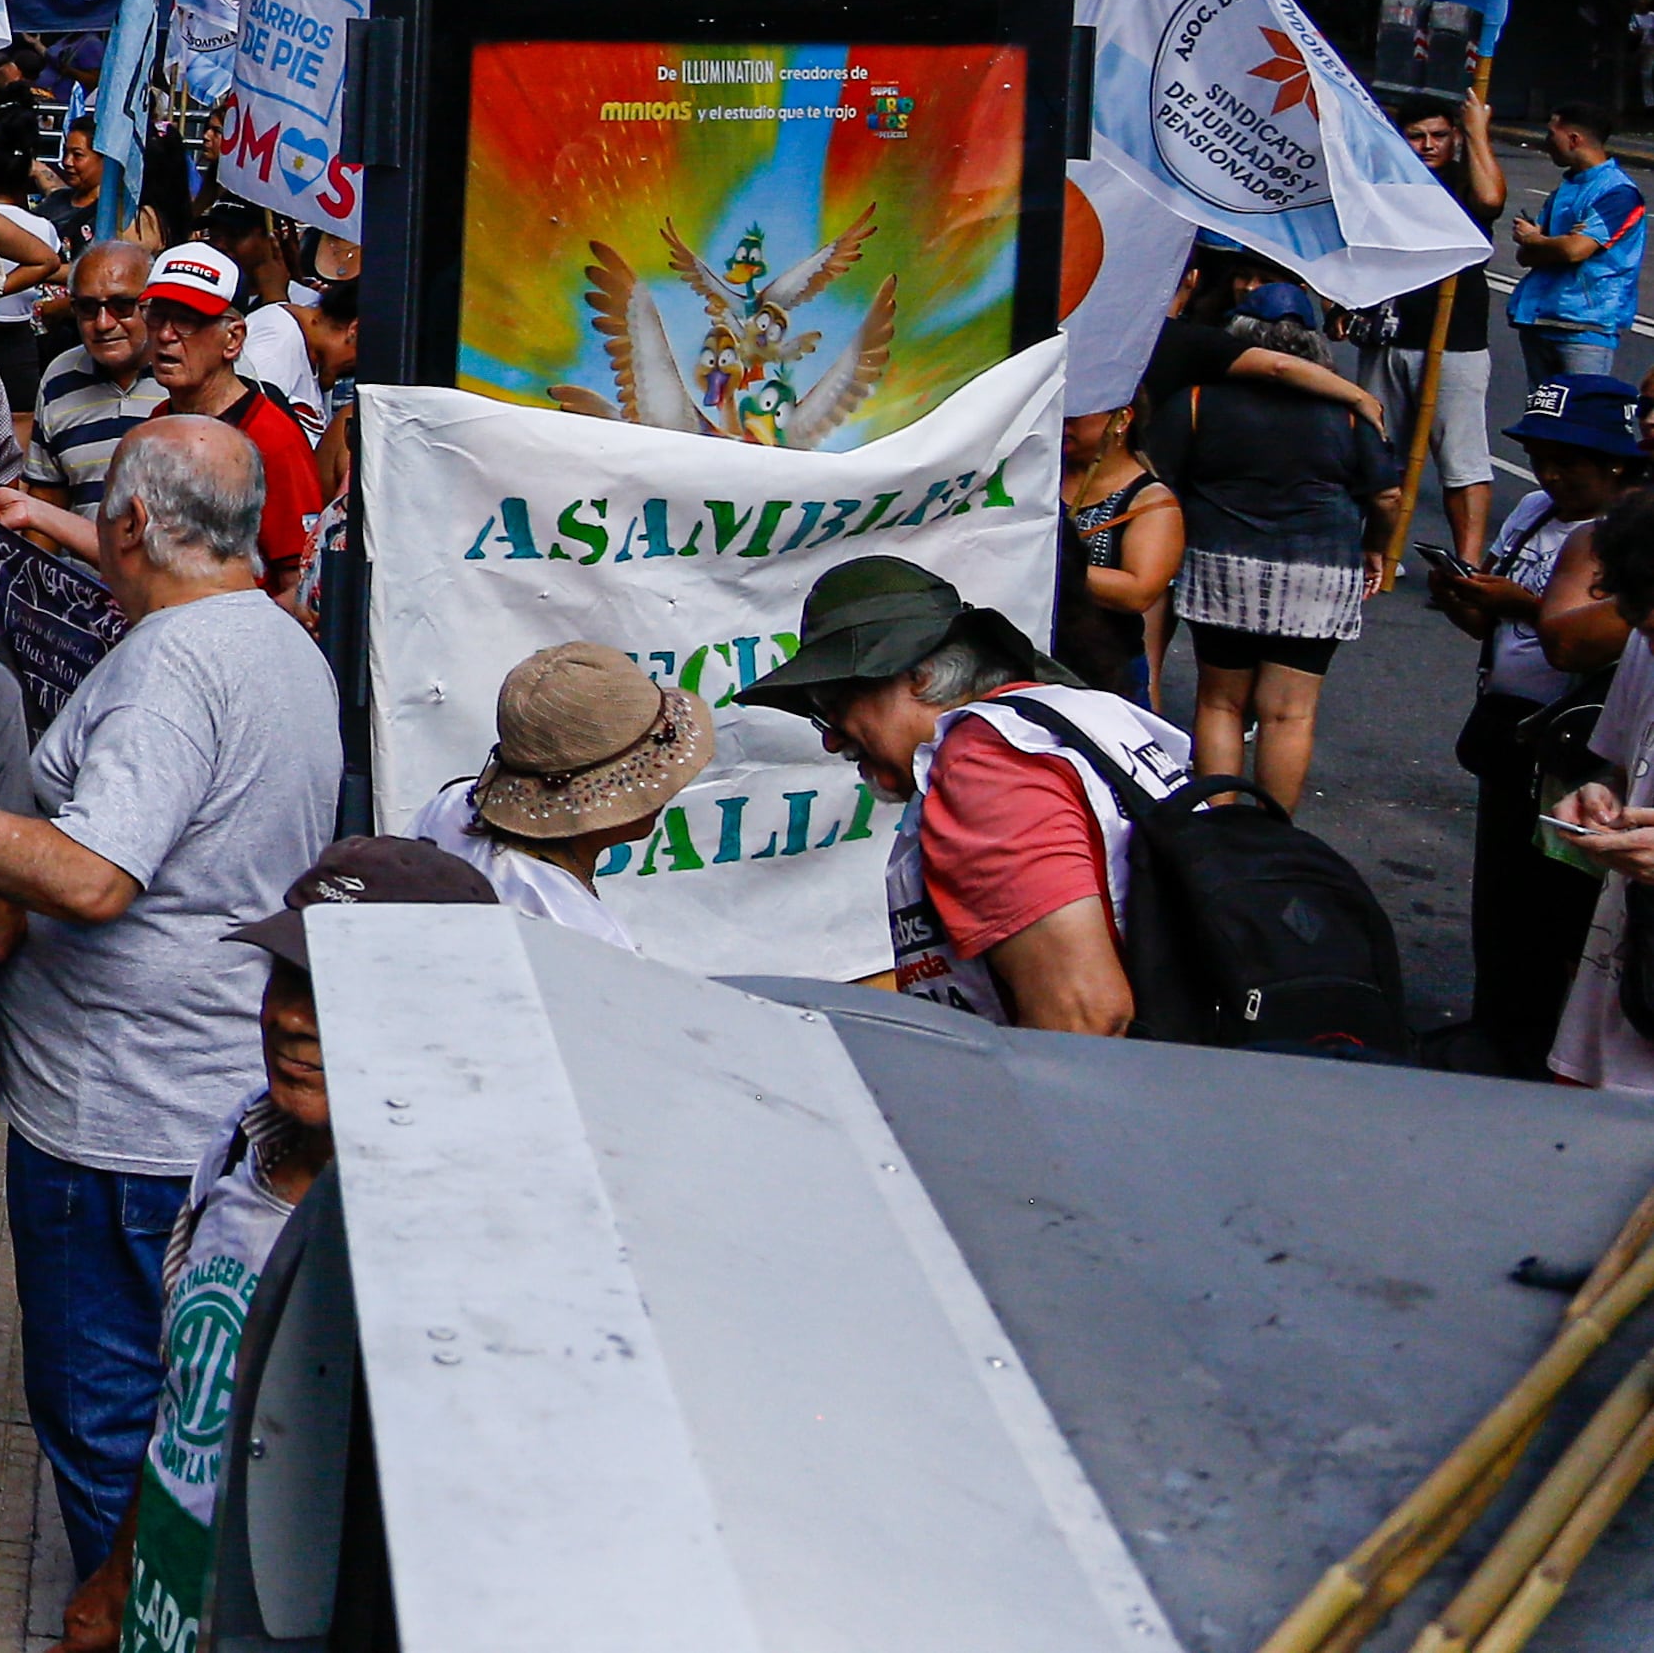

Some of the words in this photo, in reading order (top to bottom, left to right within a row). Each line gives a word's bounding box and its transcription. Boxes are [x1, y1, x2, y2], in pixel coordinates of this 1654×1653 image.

[239, 19, 270, 67] DE
[270, 34, 325, 90] PIE
[658, 66, 678, 81] De
[682, 59, 775, 84] ILLUMINATION
[778, 67, 848, 80] creadores
[850, 67, 869, 80] de
[1175, 5, 1218, 62] ASOC.
[697, 108, 706, 123] y
[709, 104, 722, 120] el
[724, 104, 775, 120] estudio
[777, 107, 805, 123] que
[807, 104, 821, 120] te
[824, 104, 857, 123] trajo
[1163, 80, 1197, 109] DE
[1191, 103, 1303, 188] JUBILAD@S
[1300, 179, 1320, 194] Y
[1204, 82, 1317, 170] SINDICATO
[1156, 103, 1295, 207] PENSIONAD@S
[464, 457, 1017, 566] ASAMBLEA
